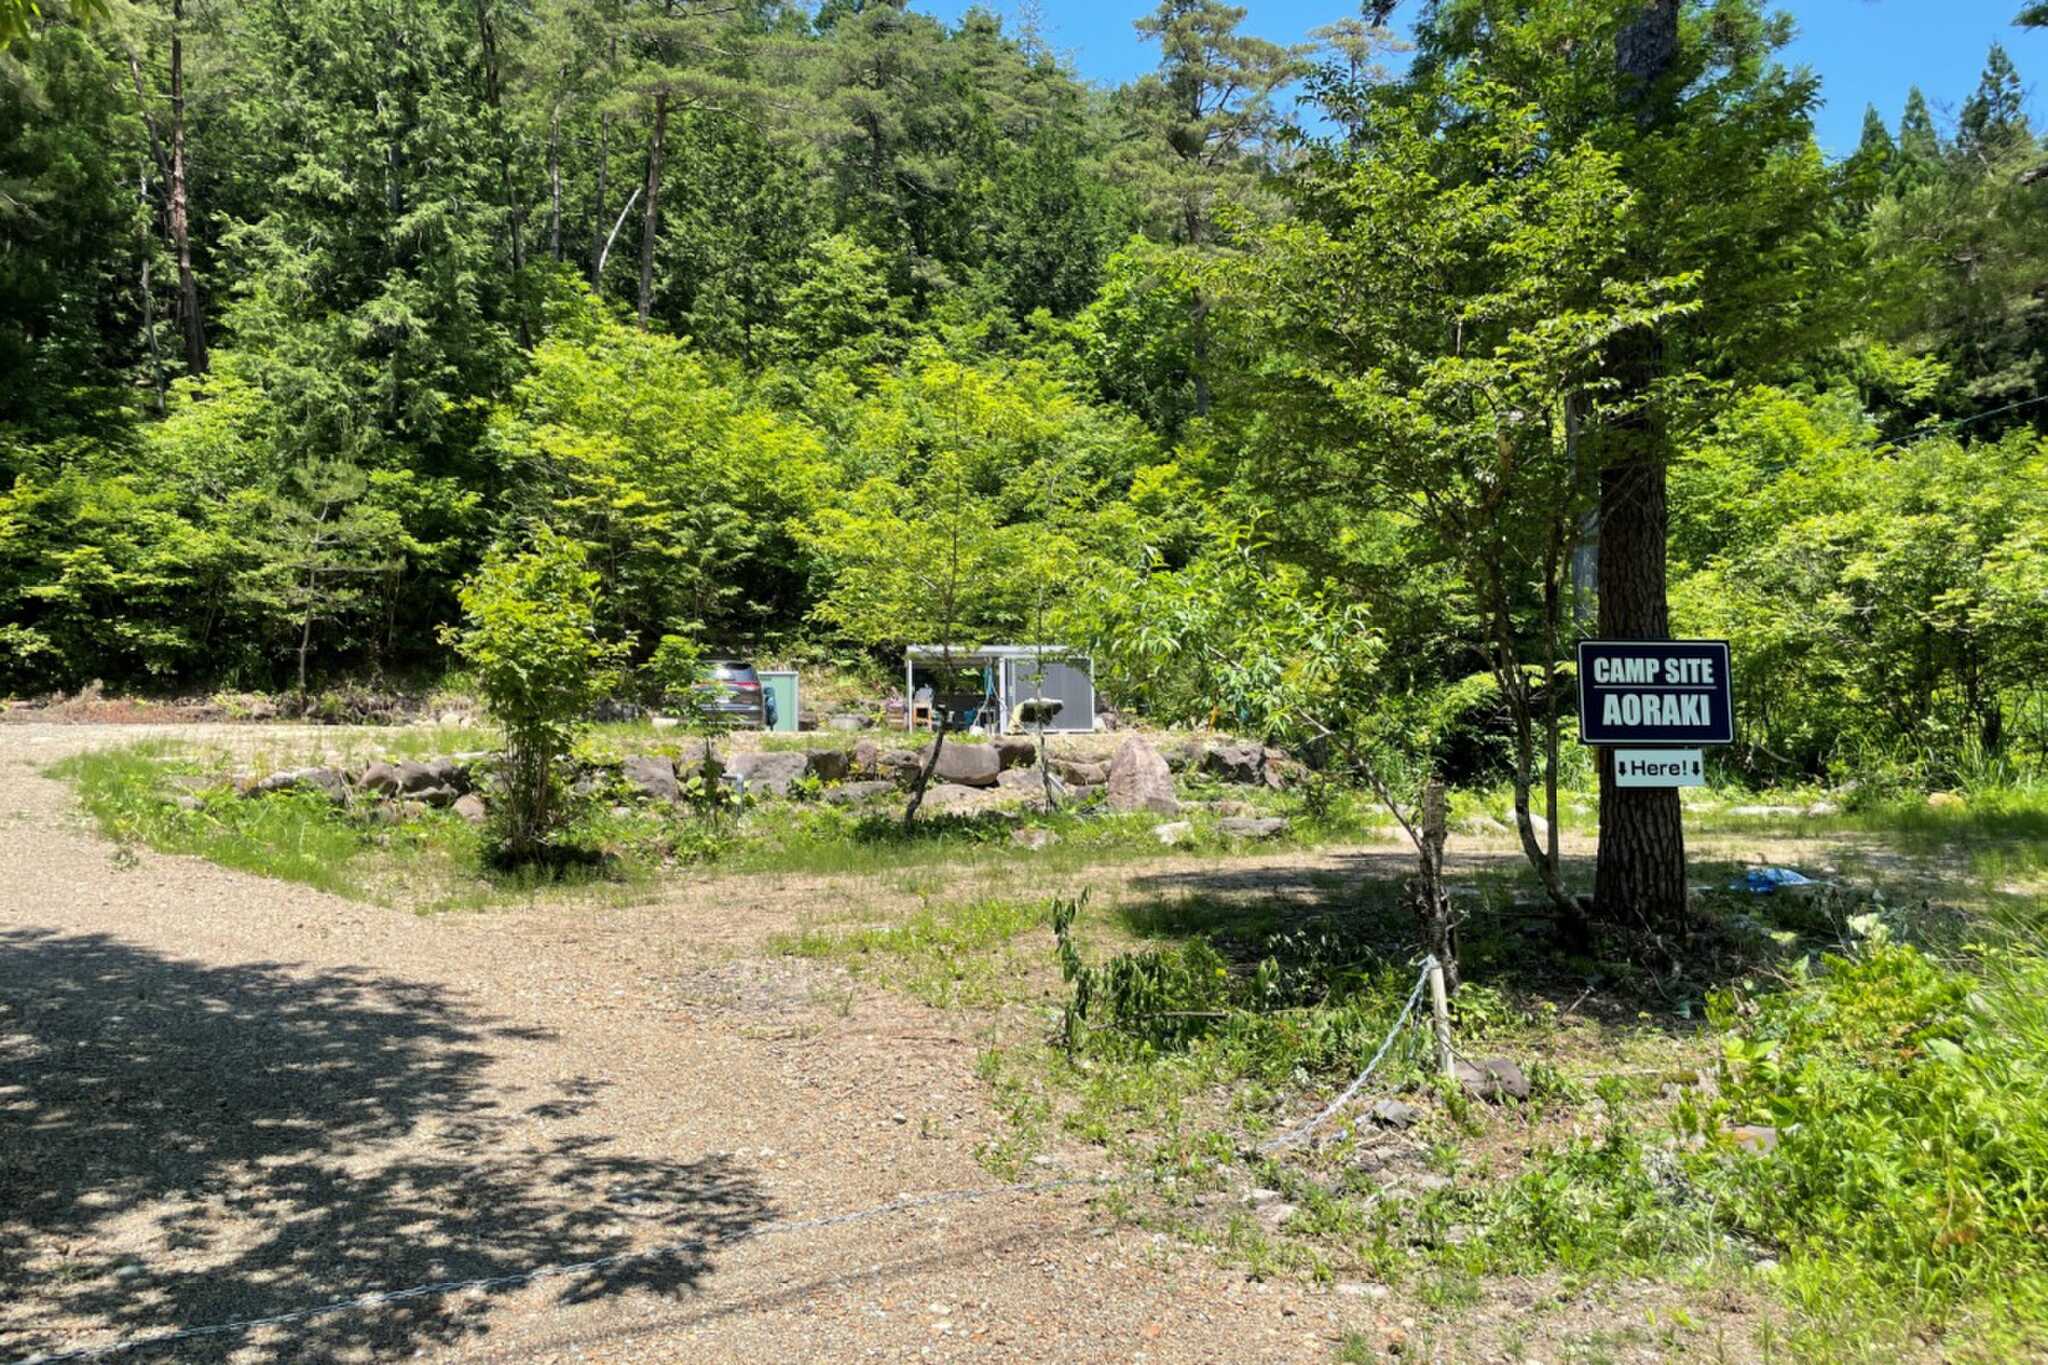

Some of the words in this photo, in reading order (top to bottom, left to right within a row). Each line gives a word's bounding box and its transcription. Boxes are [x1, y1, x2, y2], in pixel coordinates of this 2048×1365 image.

[1593, 657, 1660, 684] CAMP
[1664, 657, 1715, 684] SITE
[1602, 693, 1711, 726] AORAKI
[1631, 760, 1687, 776] Here!
